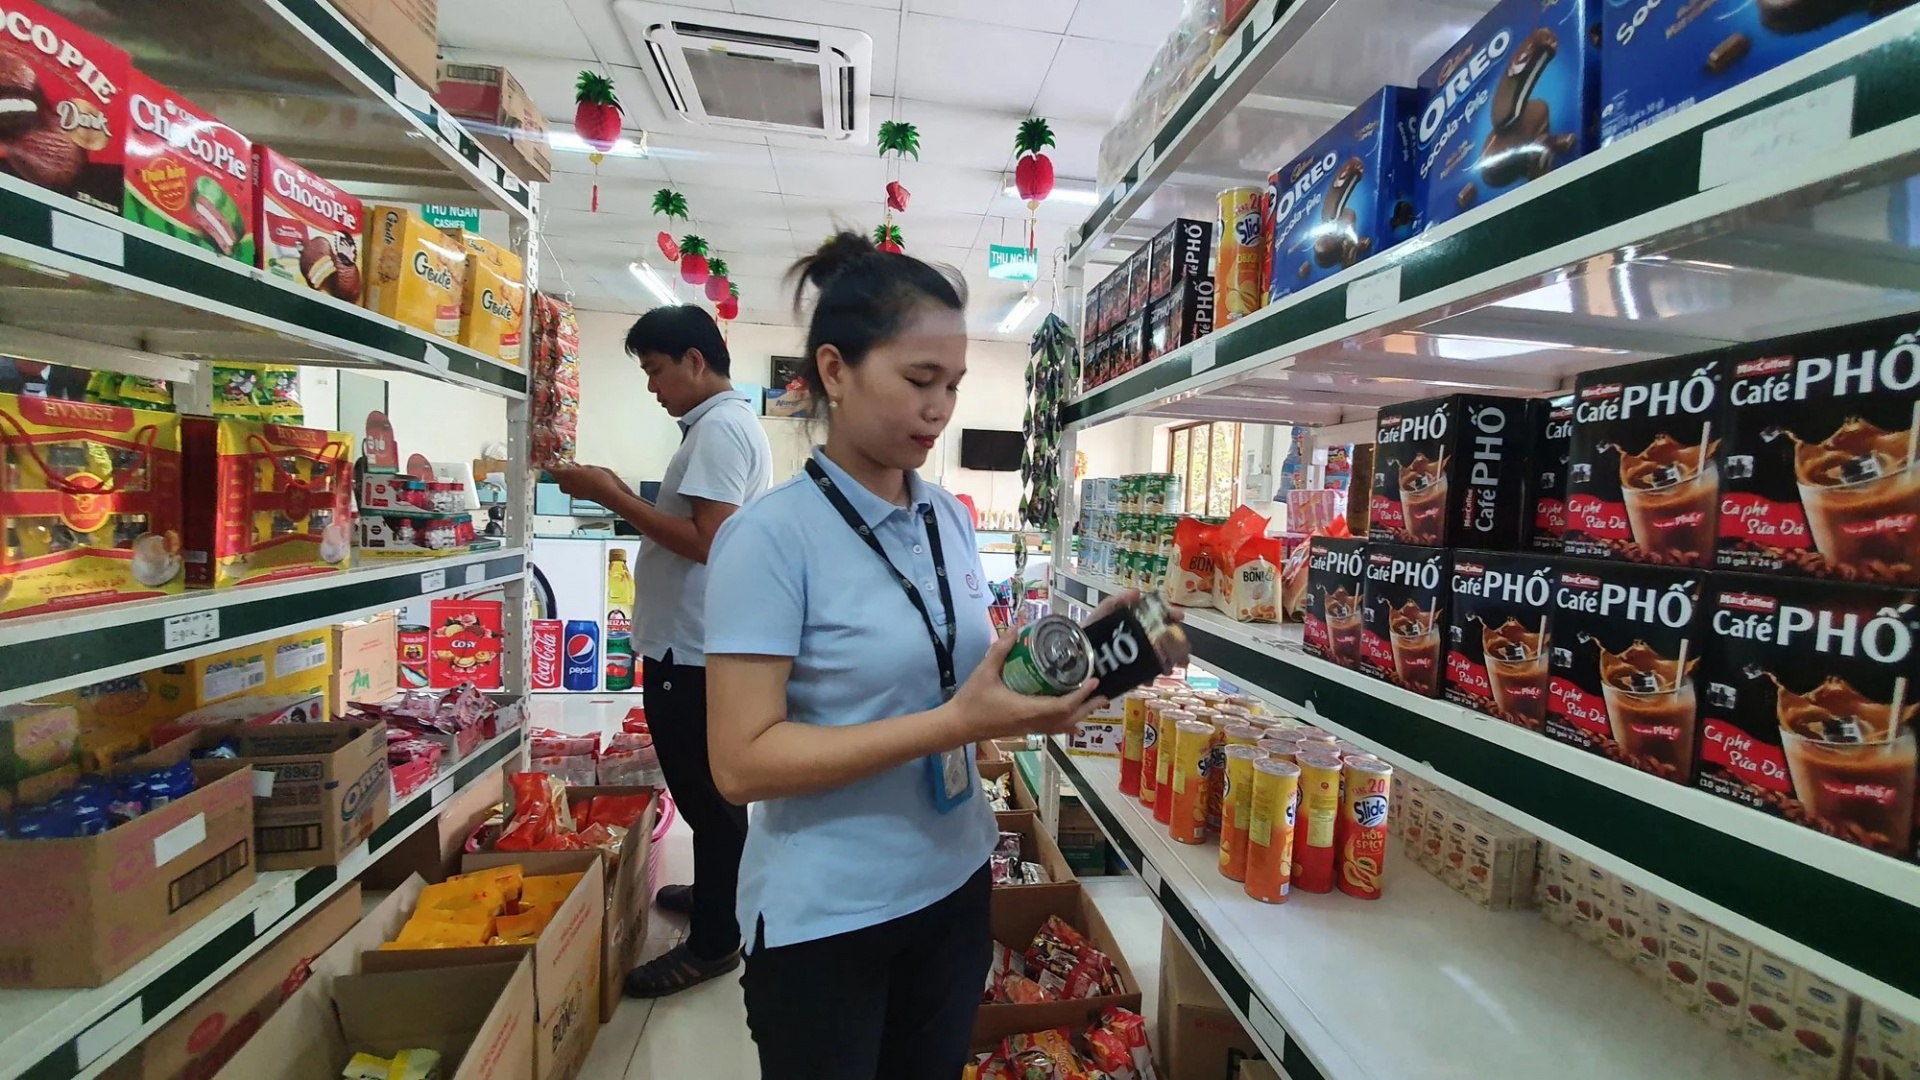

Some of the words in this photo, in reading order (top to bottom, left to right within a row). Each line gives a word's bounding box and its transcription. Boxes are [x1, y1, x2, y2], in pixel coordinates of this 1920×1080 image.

[0, 7, 117, 104] COPIE
[1419, 31, 1509, 143] OREO
[56, 100, 112, 137] Dark
[129, 93, 247, 181] ChcoPie
[1420, 89, 1489, 179] Socola-pie
[273, 168, 356, 230] ChocoPie
[1277, 152, 1337, 223] OREO
[991, 250, 1008, 264] THU
[1184, 223, 1202, 264] PHỐ
[1193, 280, 1214, 323] PHỐ
[1730, 374, 1791, 407] Café
[1794, 328, 1920, 401] PHỐ
[1577, 397, 1621, 424] Café
[1620, 361, 1719, 420] PHỐ
[1378, 426, 1400, 444] Café
[1400, 403, 1449, 442] PHỐ
[1469, 405, 1506, 486] PHỐ
[1475, 489, 1497, 532] Café
[1243, 570, 1264, 583] BON!
[1309, 555, 1327, 572] Café
[1326, 547, 1364, 577] PHỐ
[1366, 563, 1390, 582] Café
[1390, 555, 1441, 590] PHỐ
[1451, 574, 1482, 596] Café
[1482, 566, 1551, 607] PHỐ
[1556, 588, 1599, 613] Café
[1599, 580, 1696, 629] PHỐ
[1719, 592, 1774, 609] MacCoffee
[1093, 620, 1140, 676] HỐ
[1712, 610, 1773, 642] Café
[1776, 603, 1916, 663] PHỐ
[569, 666, 592, 675] pepsi
[1354, 800, 1386, 826] Slide
